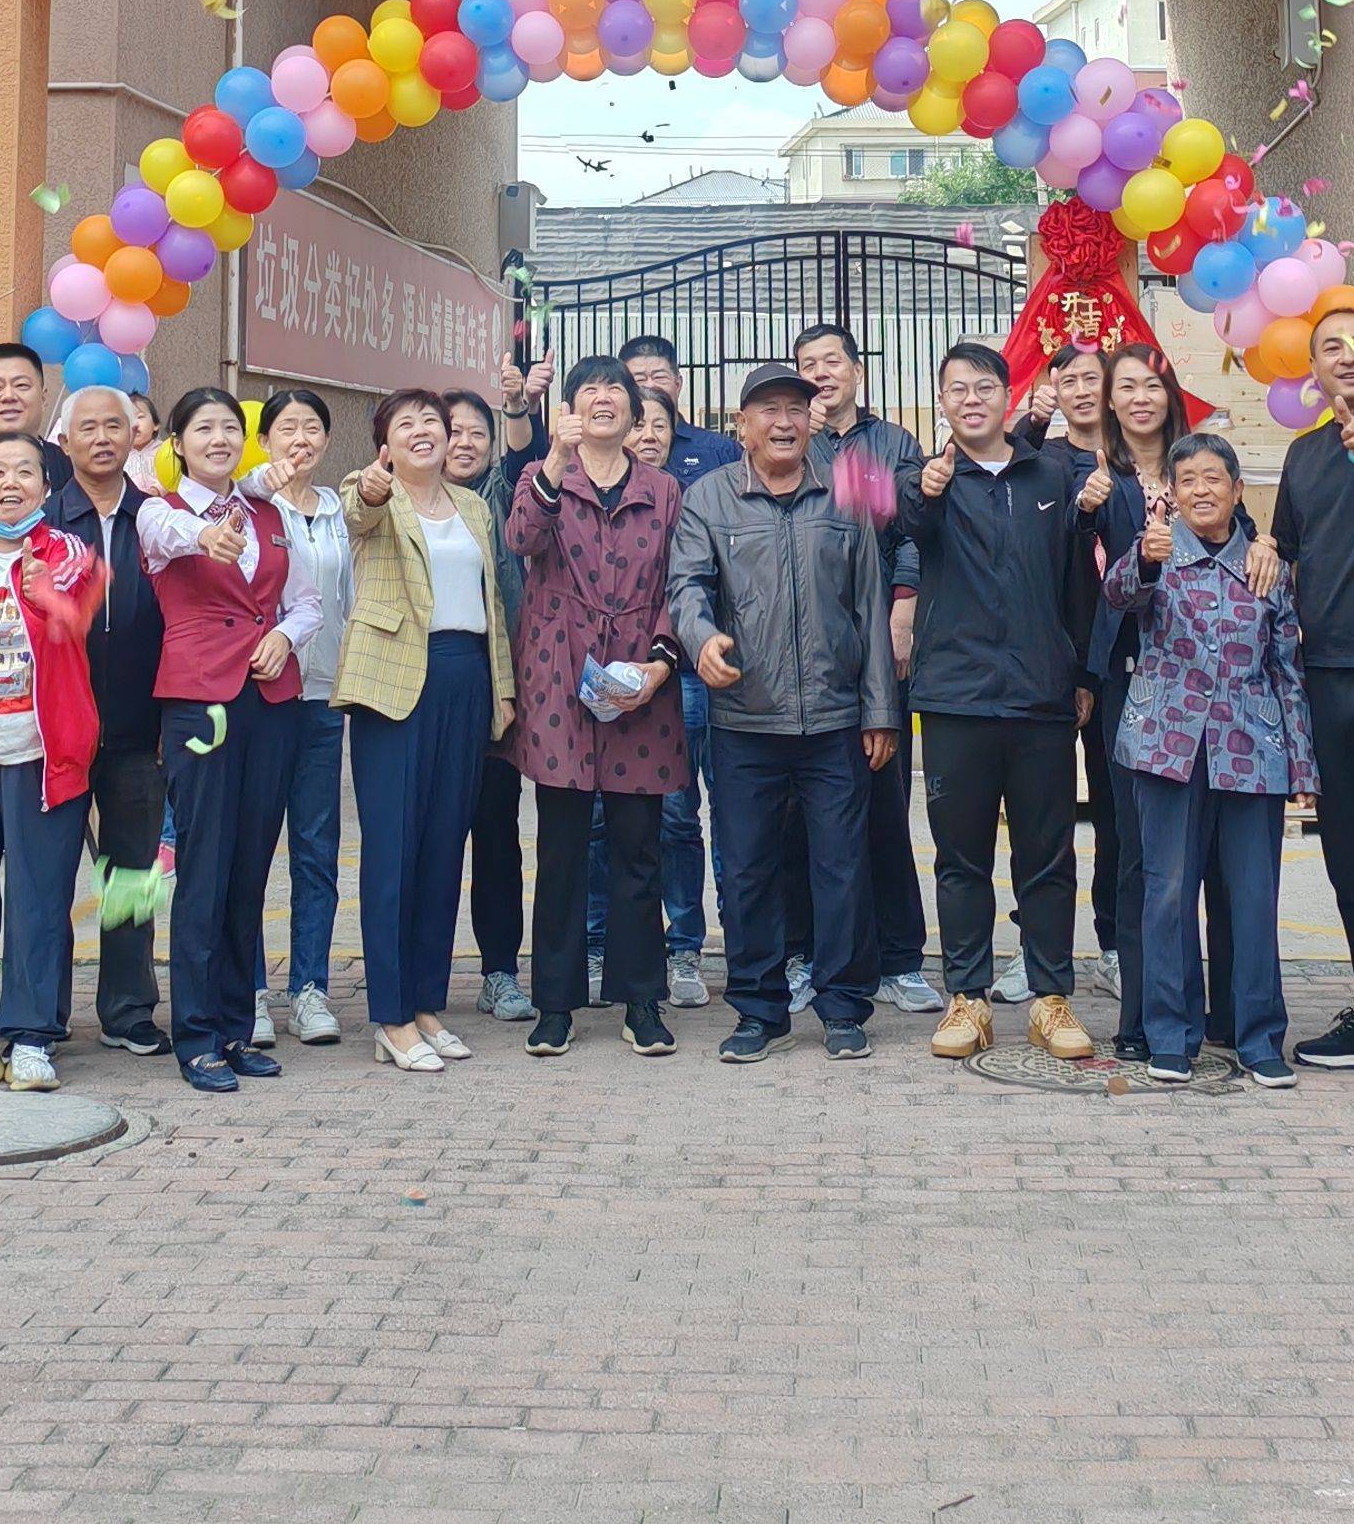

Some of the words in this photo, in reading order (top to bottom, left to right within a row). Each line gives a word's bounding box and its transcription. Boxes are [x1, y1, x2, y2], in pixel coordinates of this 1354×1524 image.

[255, 222, 395, 352] 垃圾分类好处多
